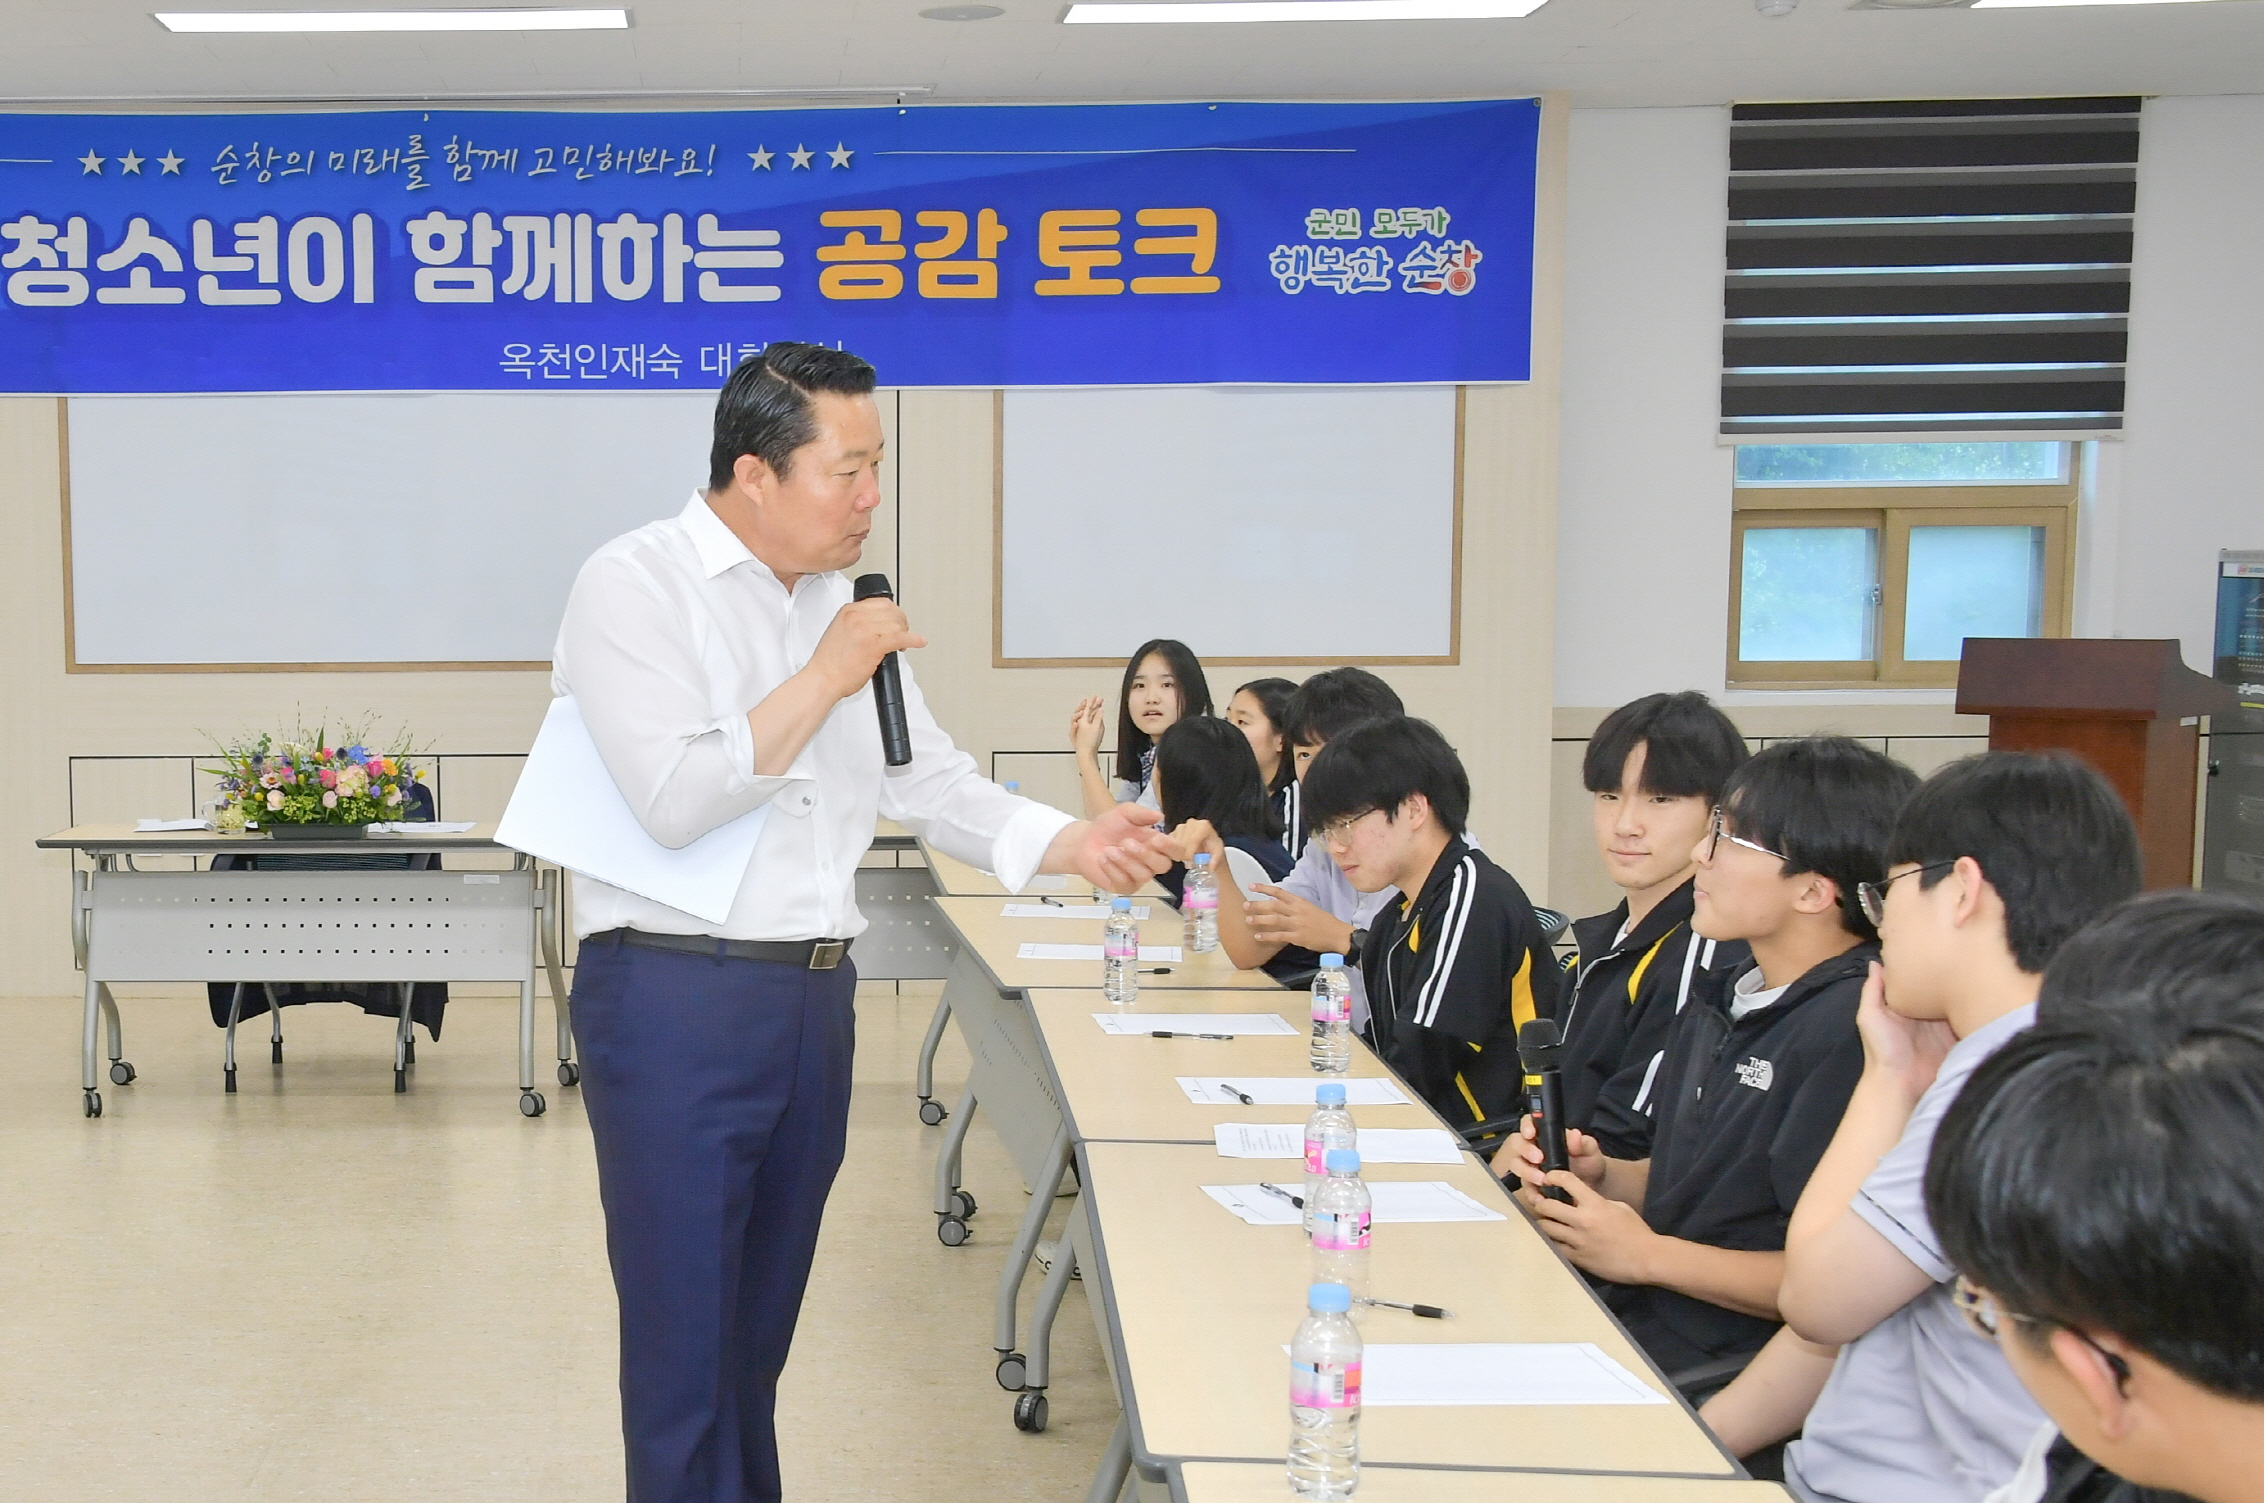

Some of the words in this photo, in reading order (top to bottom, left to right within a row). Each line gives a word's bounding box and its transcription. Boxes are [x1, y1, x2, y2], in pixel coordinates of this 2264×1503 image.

[211, 141, 315, 185] 순창의
[328, 134, 430, 191] 미래를
[443, 135, 518, 182] 함께
[528, 143, 716, 180] 고민해봐요!
[1306, 209, 1361, 238] 군민
[1371, 208, 1448, 237] 모두가
[1, 212, 374, 307] 청소년이
[406, 210, 785, 303] 함께하는
[816, 207, 1008, 300] 공감
[1034, 207, 1221, 296] 토크
[1271, 247, 1391, 292] 행복한
[1401, 242, 1481, 293] 순창
[499, 343, 683, 380] 옥천인재숙
[1734, 1063, 1767, 1079] NORTH
[1749, 1056, 1769, 1069] THE
[1739, 1074, 1763, 1088] FACE
